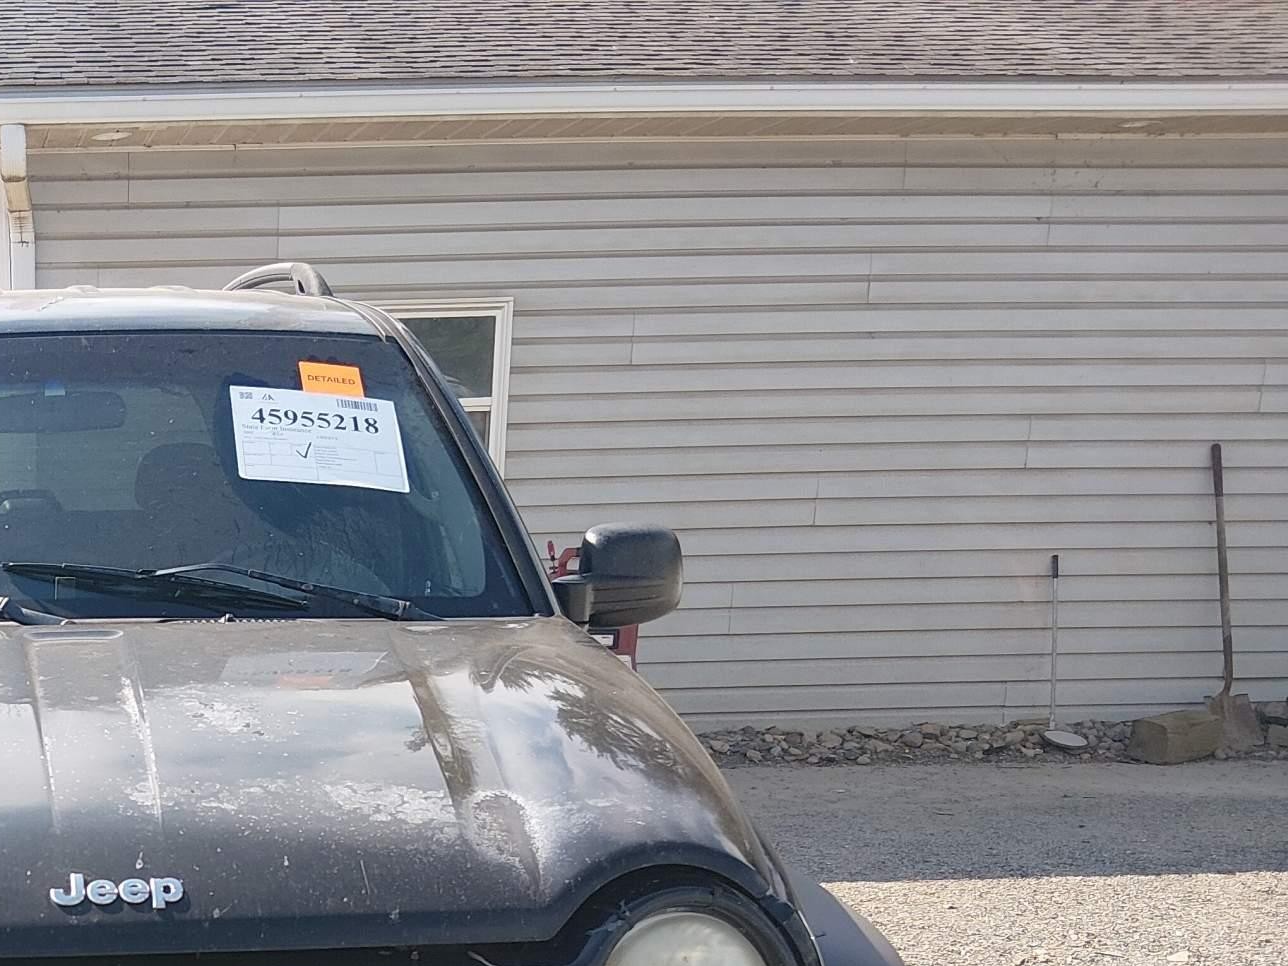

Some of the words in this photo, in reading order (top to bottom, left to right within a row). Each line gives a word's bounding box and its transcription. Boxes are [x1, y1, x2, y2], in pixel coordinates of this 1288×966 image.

[307, 374, 356, 386] DETAILED
[251, 407, 380, 435] 45955218
[49, 872, 184, 909] Jeep
